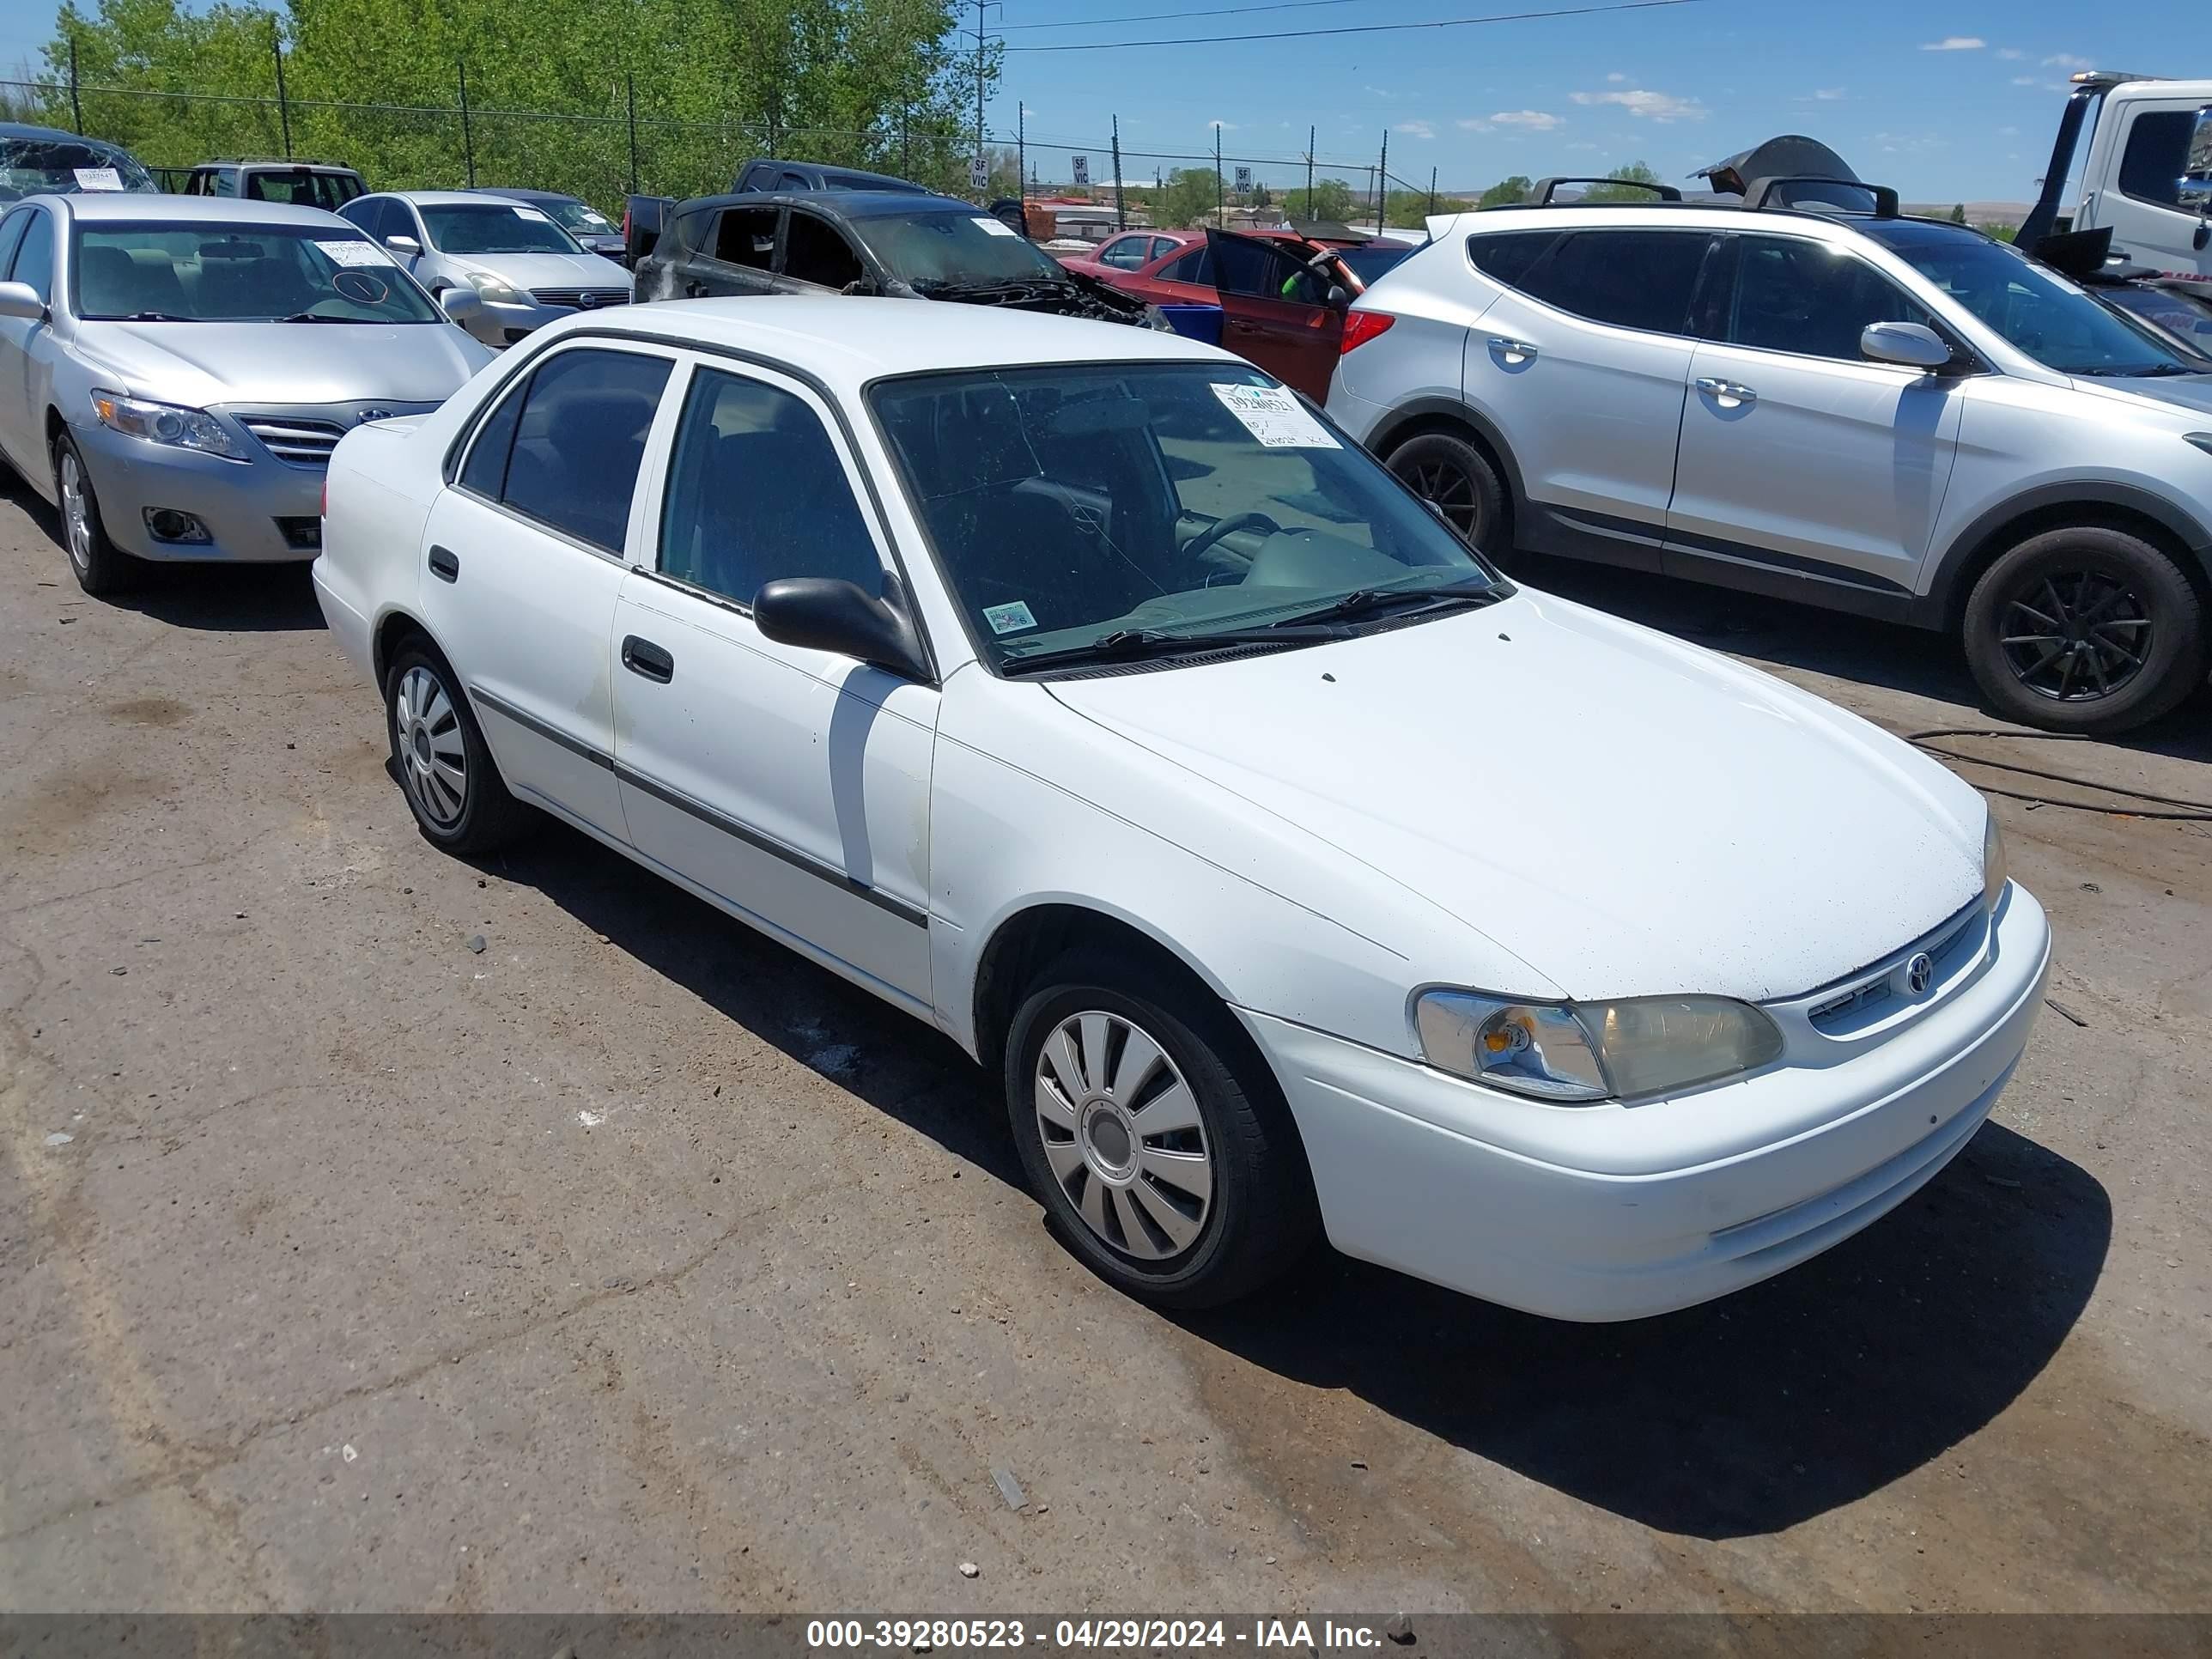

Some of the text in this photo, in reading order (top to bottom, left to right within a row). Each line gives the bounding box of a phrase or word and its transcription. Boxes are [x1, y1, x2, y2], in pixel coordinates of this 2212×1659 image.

[975, 160, 986, 171] SF
[1075, 158, 1085, 169] SF
[1075, 173, 1089, 184] VIC
[1238, 169, 1248, 179] SF
[972, 174, 987, 187] VIC
[1237, 183, 1250, 193] VIC
[1227, 397, 1295, 412] 39280523
